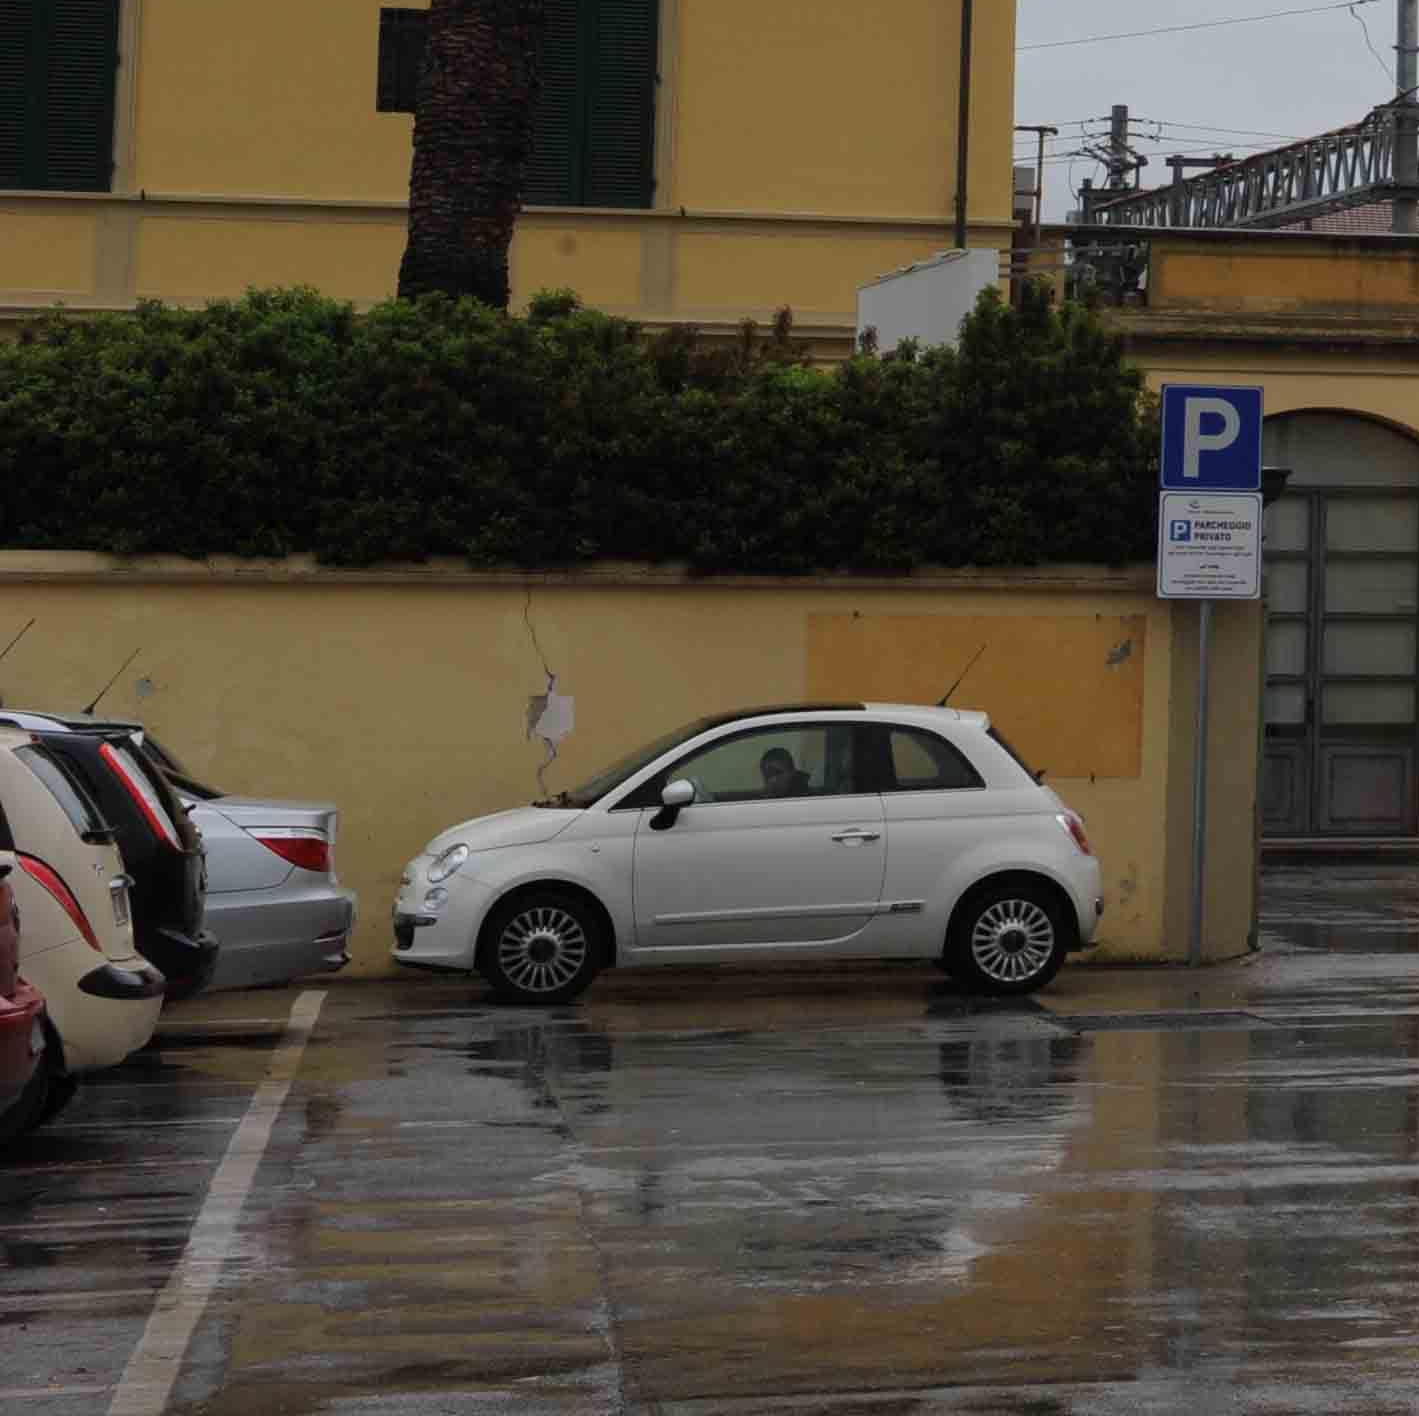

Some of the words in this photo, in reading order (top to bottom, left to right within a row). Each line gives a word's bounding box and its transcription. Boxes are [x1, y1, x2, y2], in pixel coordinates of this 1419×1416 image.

[1183, 396, 1241, 478] P
[1194, 520, 1251, 530] PARCHEGGIO
[1194, 532, 1231, 541] PRIVATO
